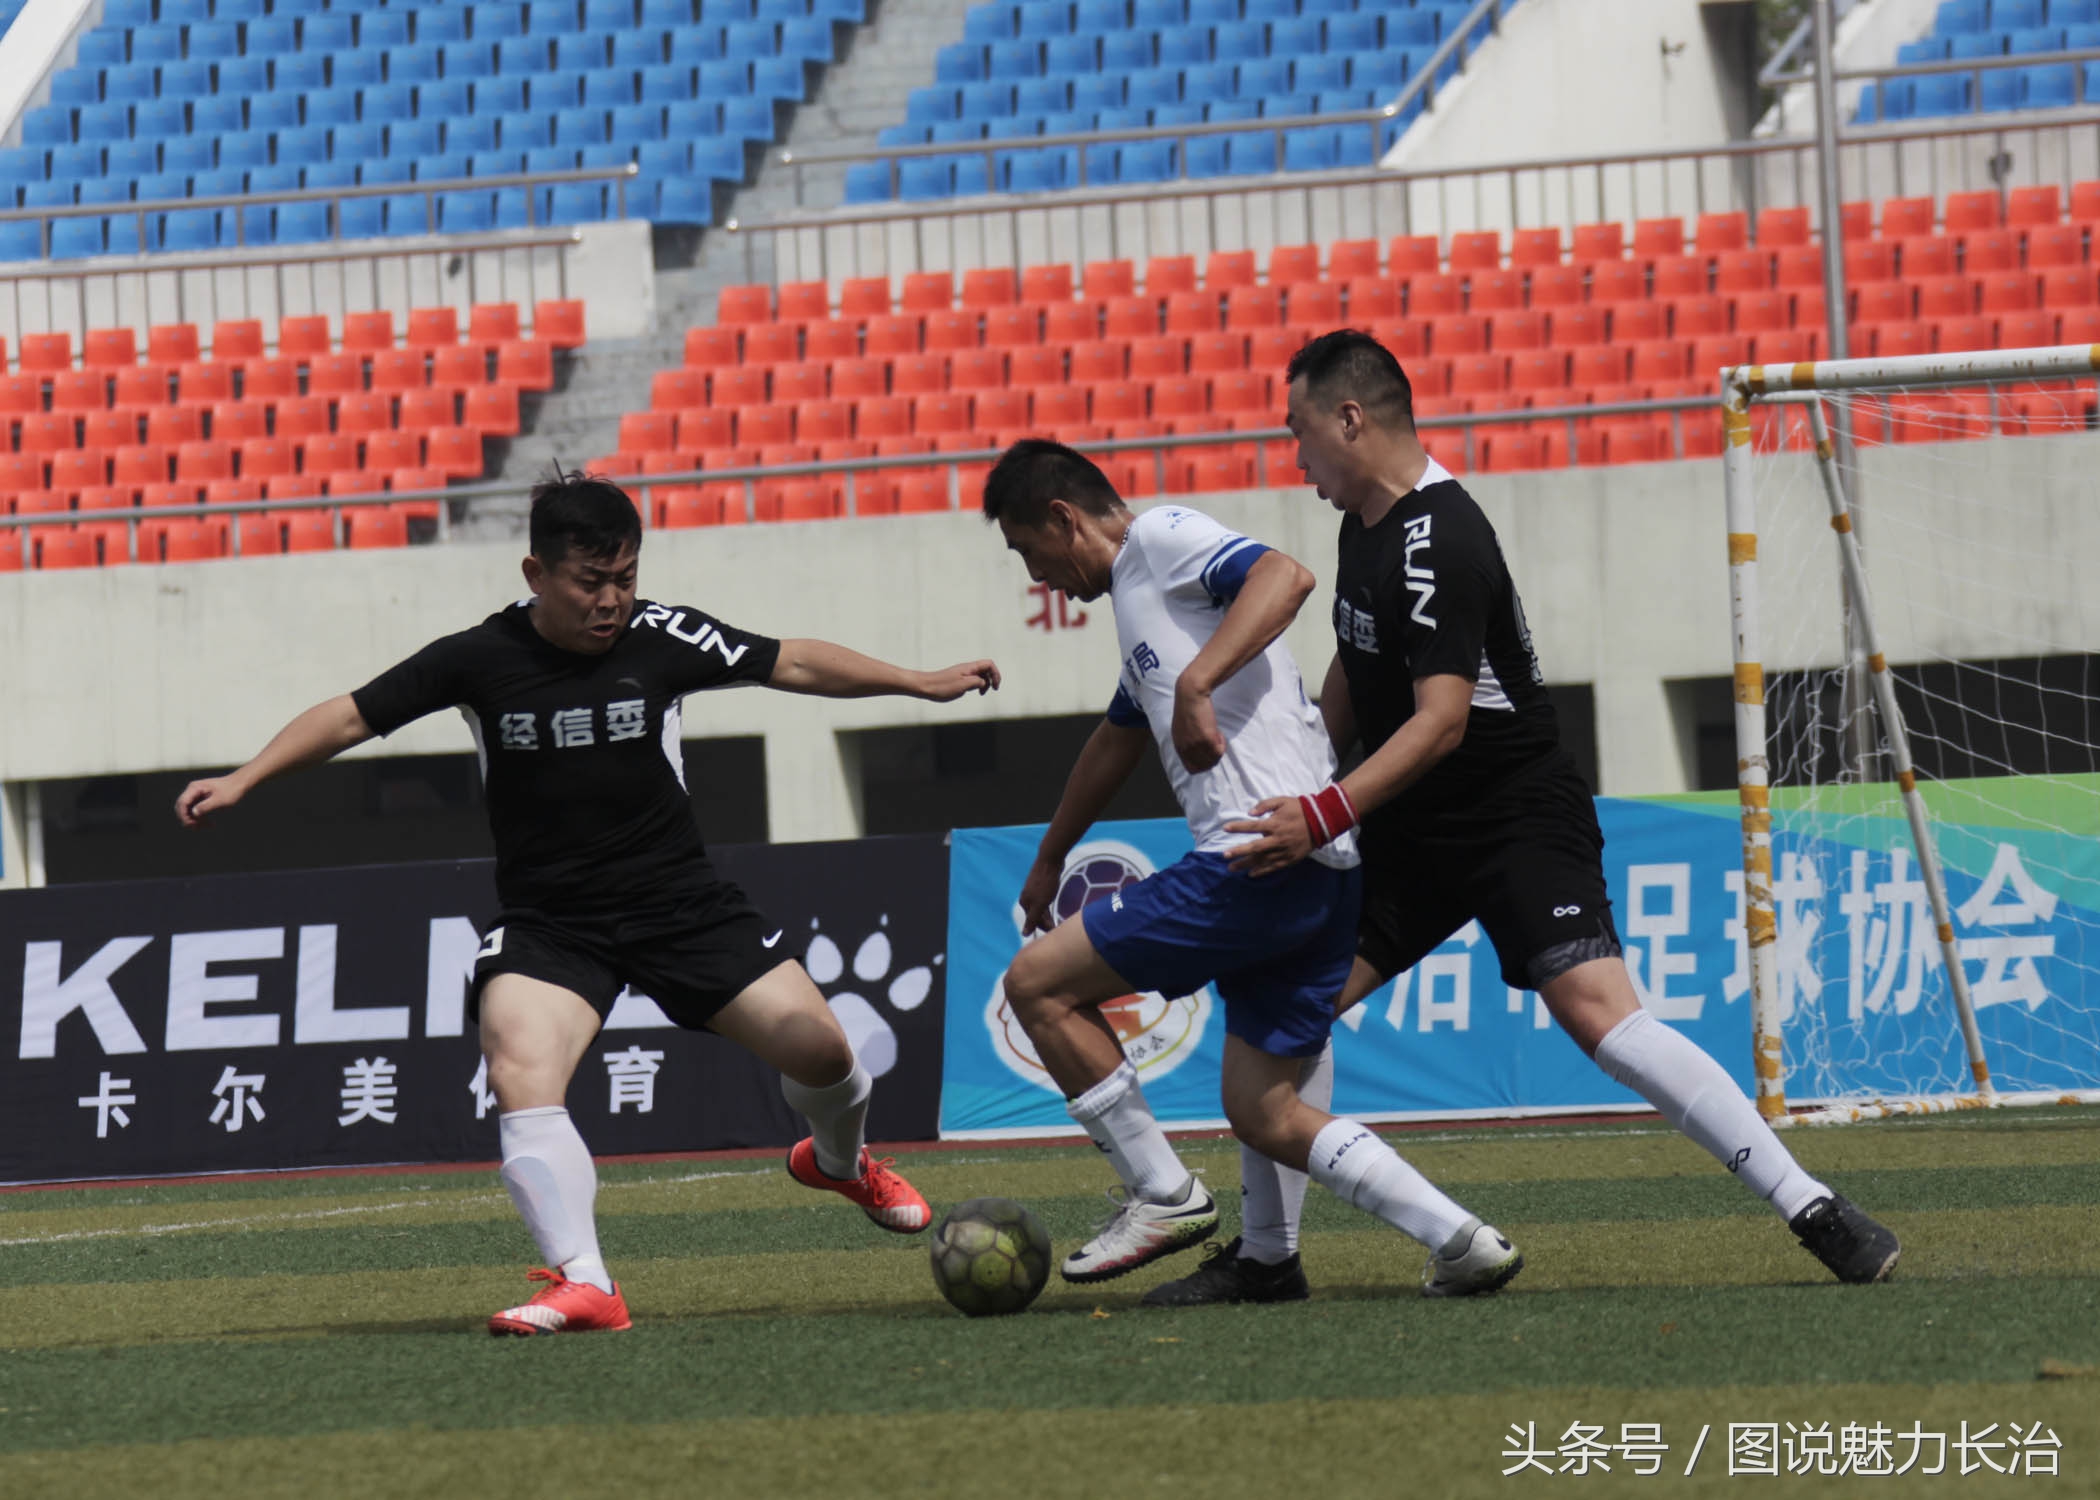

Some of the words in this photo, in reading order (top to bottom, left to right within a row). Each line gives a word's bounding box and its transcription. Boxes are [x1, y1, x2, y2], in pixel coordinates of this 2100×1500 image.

[1403, 513, 1438, 631] RUN
[629, 603, 750, 667] RUN
[1026, 580, 1088, 632] 北
[499, 698, 648, 750] 经信委
